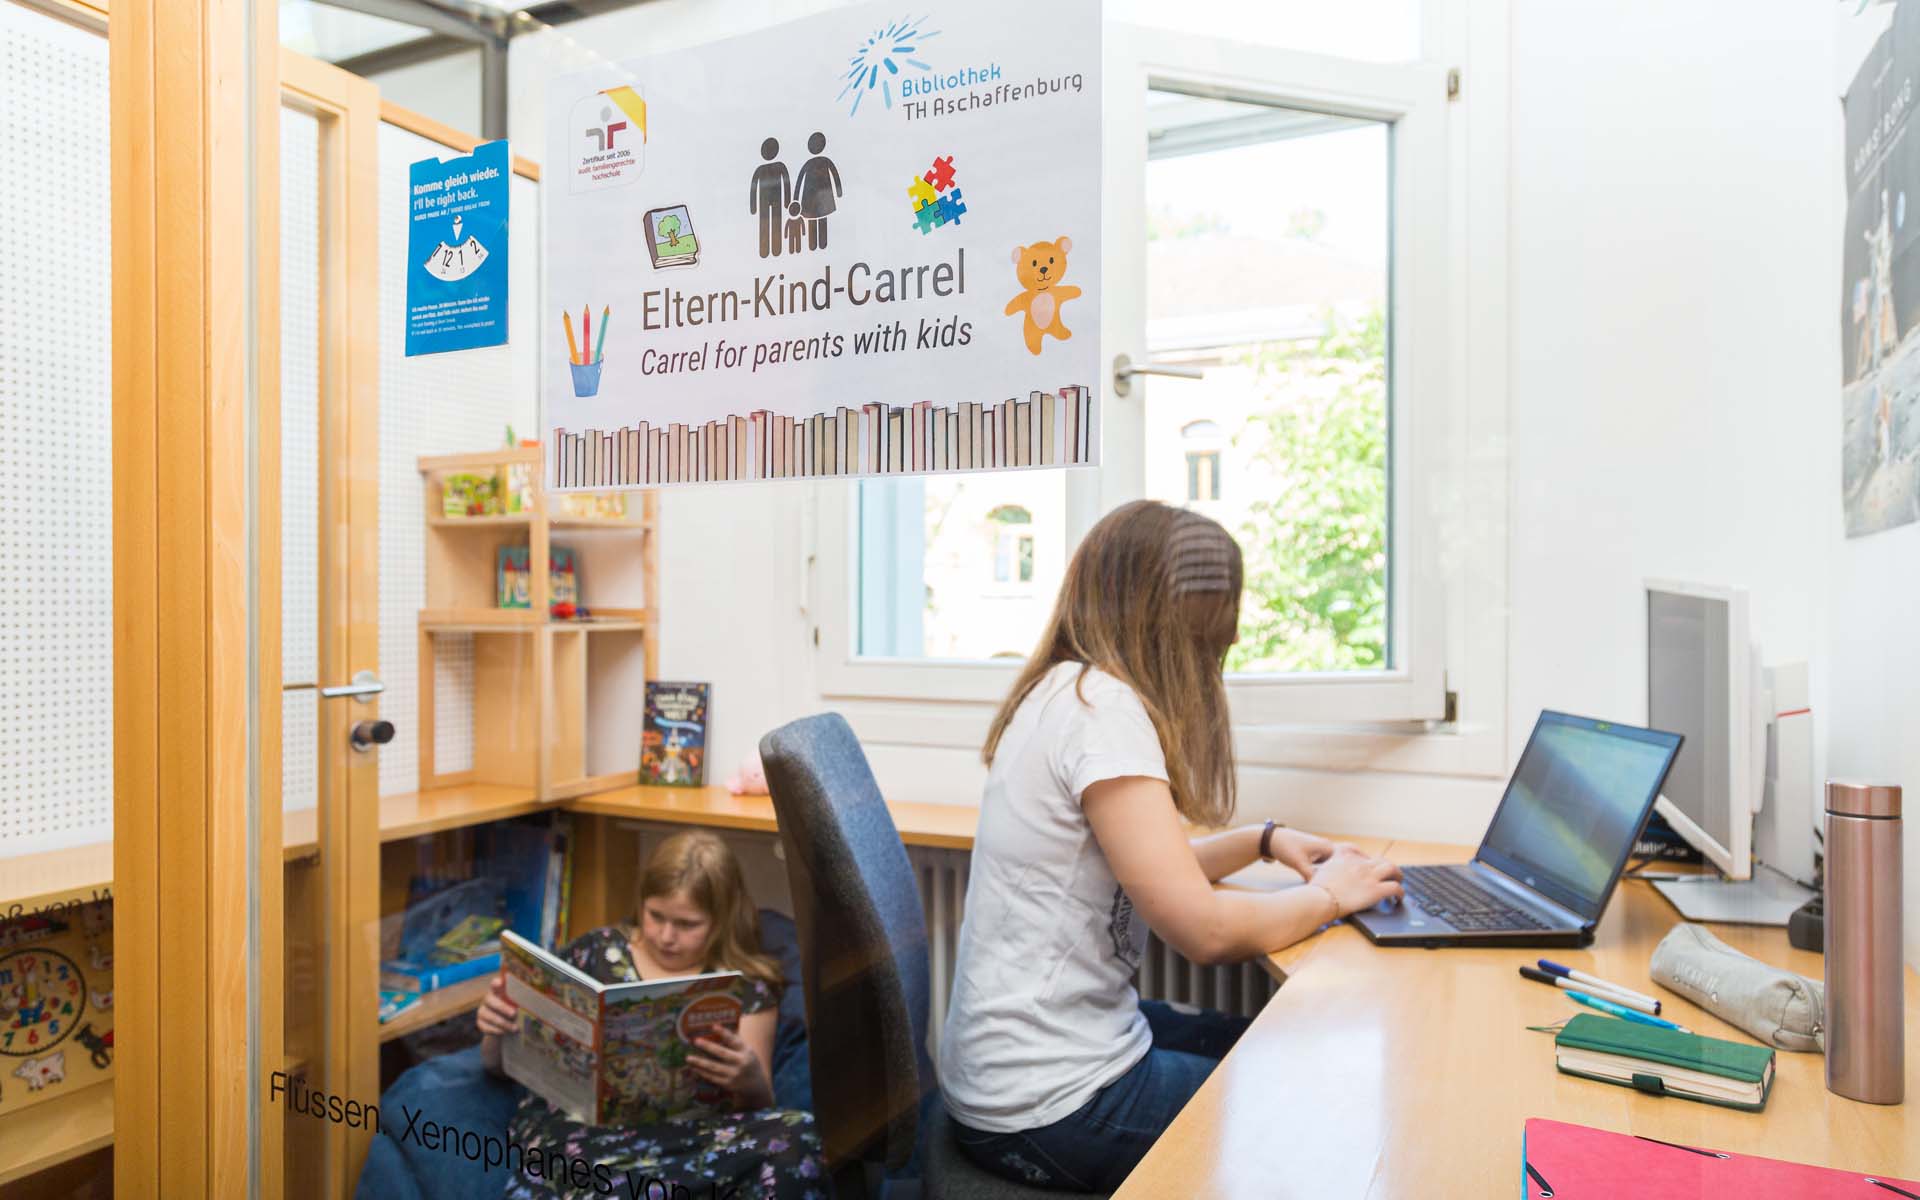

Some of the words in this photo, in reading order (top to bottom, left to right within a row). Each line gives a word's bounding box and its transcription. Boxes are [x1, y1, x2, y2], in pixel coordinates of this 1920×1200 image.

[902, 63, 1001, 98] Bibliothek
[903, 100, 927, 121] TH
[934, 73, 1083, 117] Aschaffenburg
[606, 152, 616, 160] seit
[617, 149, 631, 158] 2006
[413, 180, 443, 196] Komme
[445, 172, 468, 192] gleich
[469, 168, 500, 183] wieder.
[413, 197, 425, 211] I'll
[425, 195, 435, 209] be
[436, 190, 456, 207] right
[457, 188, 478, 202] back.
[442, 249, 454, 268] 12
[458, 250, 464, 267] 1
[470, 240, 481, 255] 2
[643, 247, 965, 331] Eltern-Kind-Carrel
[641, 342, 708, 376] Carrel
[715, 340, 748, 370] for
[751, 331, 844, 373] parents
[853, 320, 907, 355] with
[916, 315, 973, 350] kids
[27, 1030, 39, 1045] 6
[401, 1104, 613, 1195] Xenophanes
